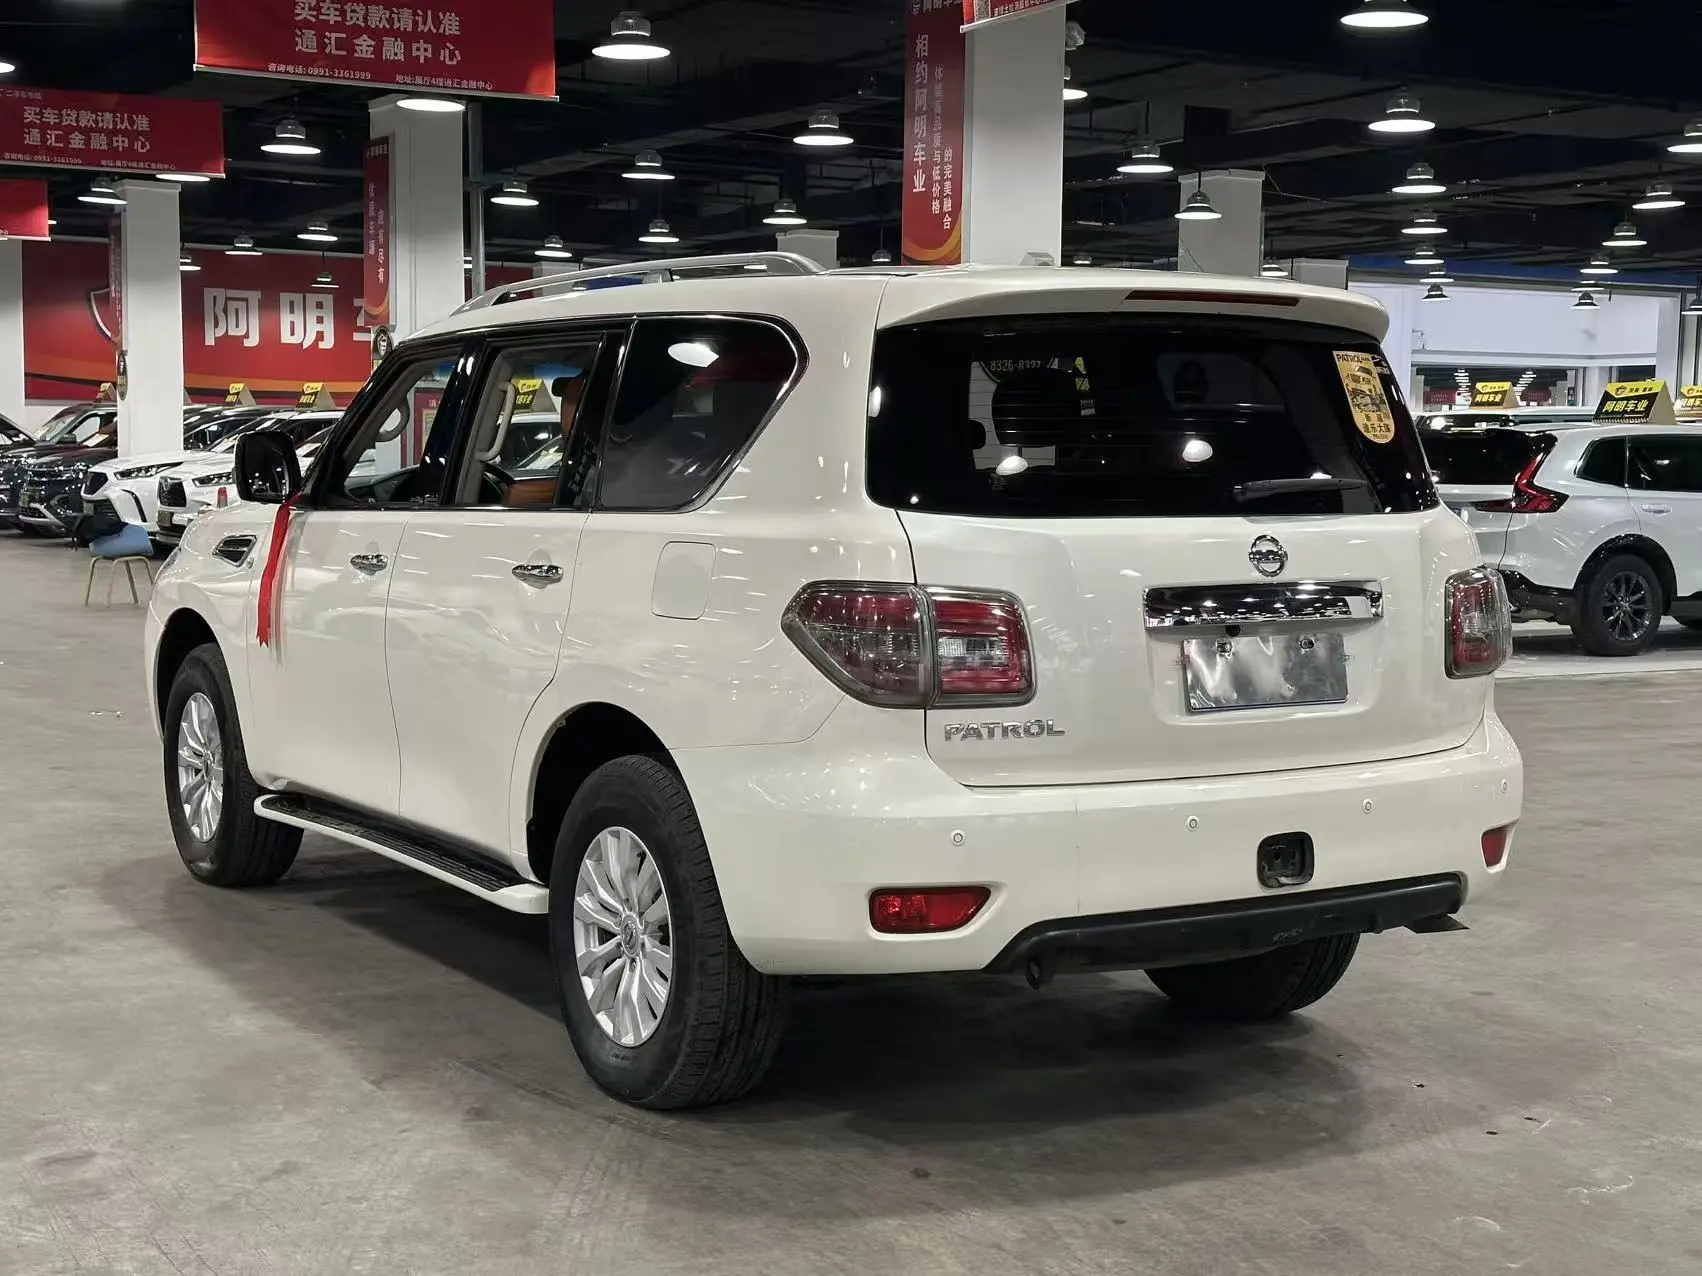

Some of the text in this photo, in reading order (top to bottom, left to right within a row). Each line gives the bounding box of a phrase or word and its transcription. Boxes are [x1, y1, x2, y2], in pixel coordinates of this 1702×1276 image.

[294, 0, 461, 36] 买车贷款请认准
[295, 29, 462, 65] 通汇金融中心
[24, 106, 150, 132] 买车贷款请认准
[912, 34, 929, 193] 相约阿明车业
[24, 128, 150, 153] 通汇金融中心
[942, 147, 953, 230] 的完美融合
[1602, 399, 1649, 413] 阿明车业
[944, 719, 1066, 741] PATROL
